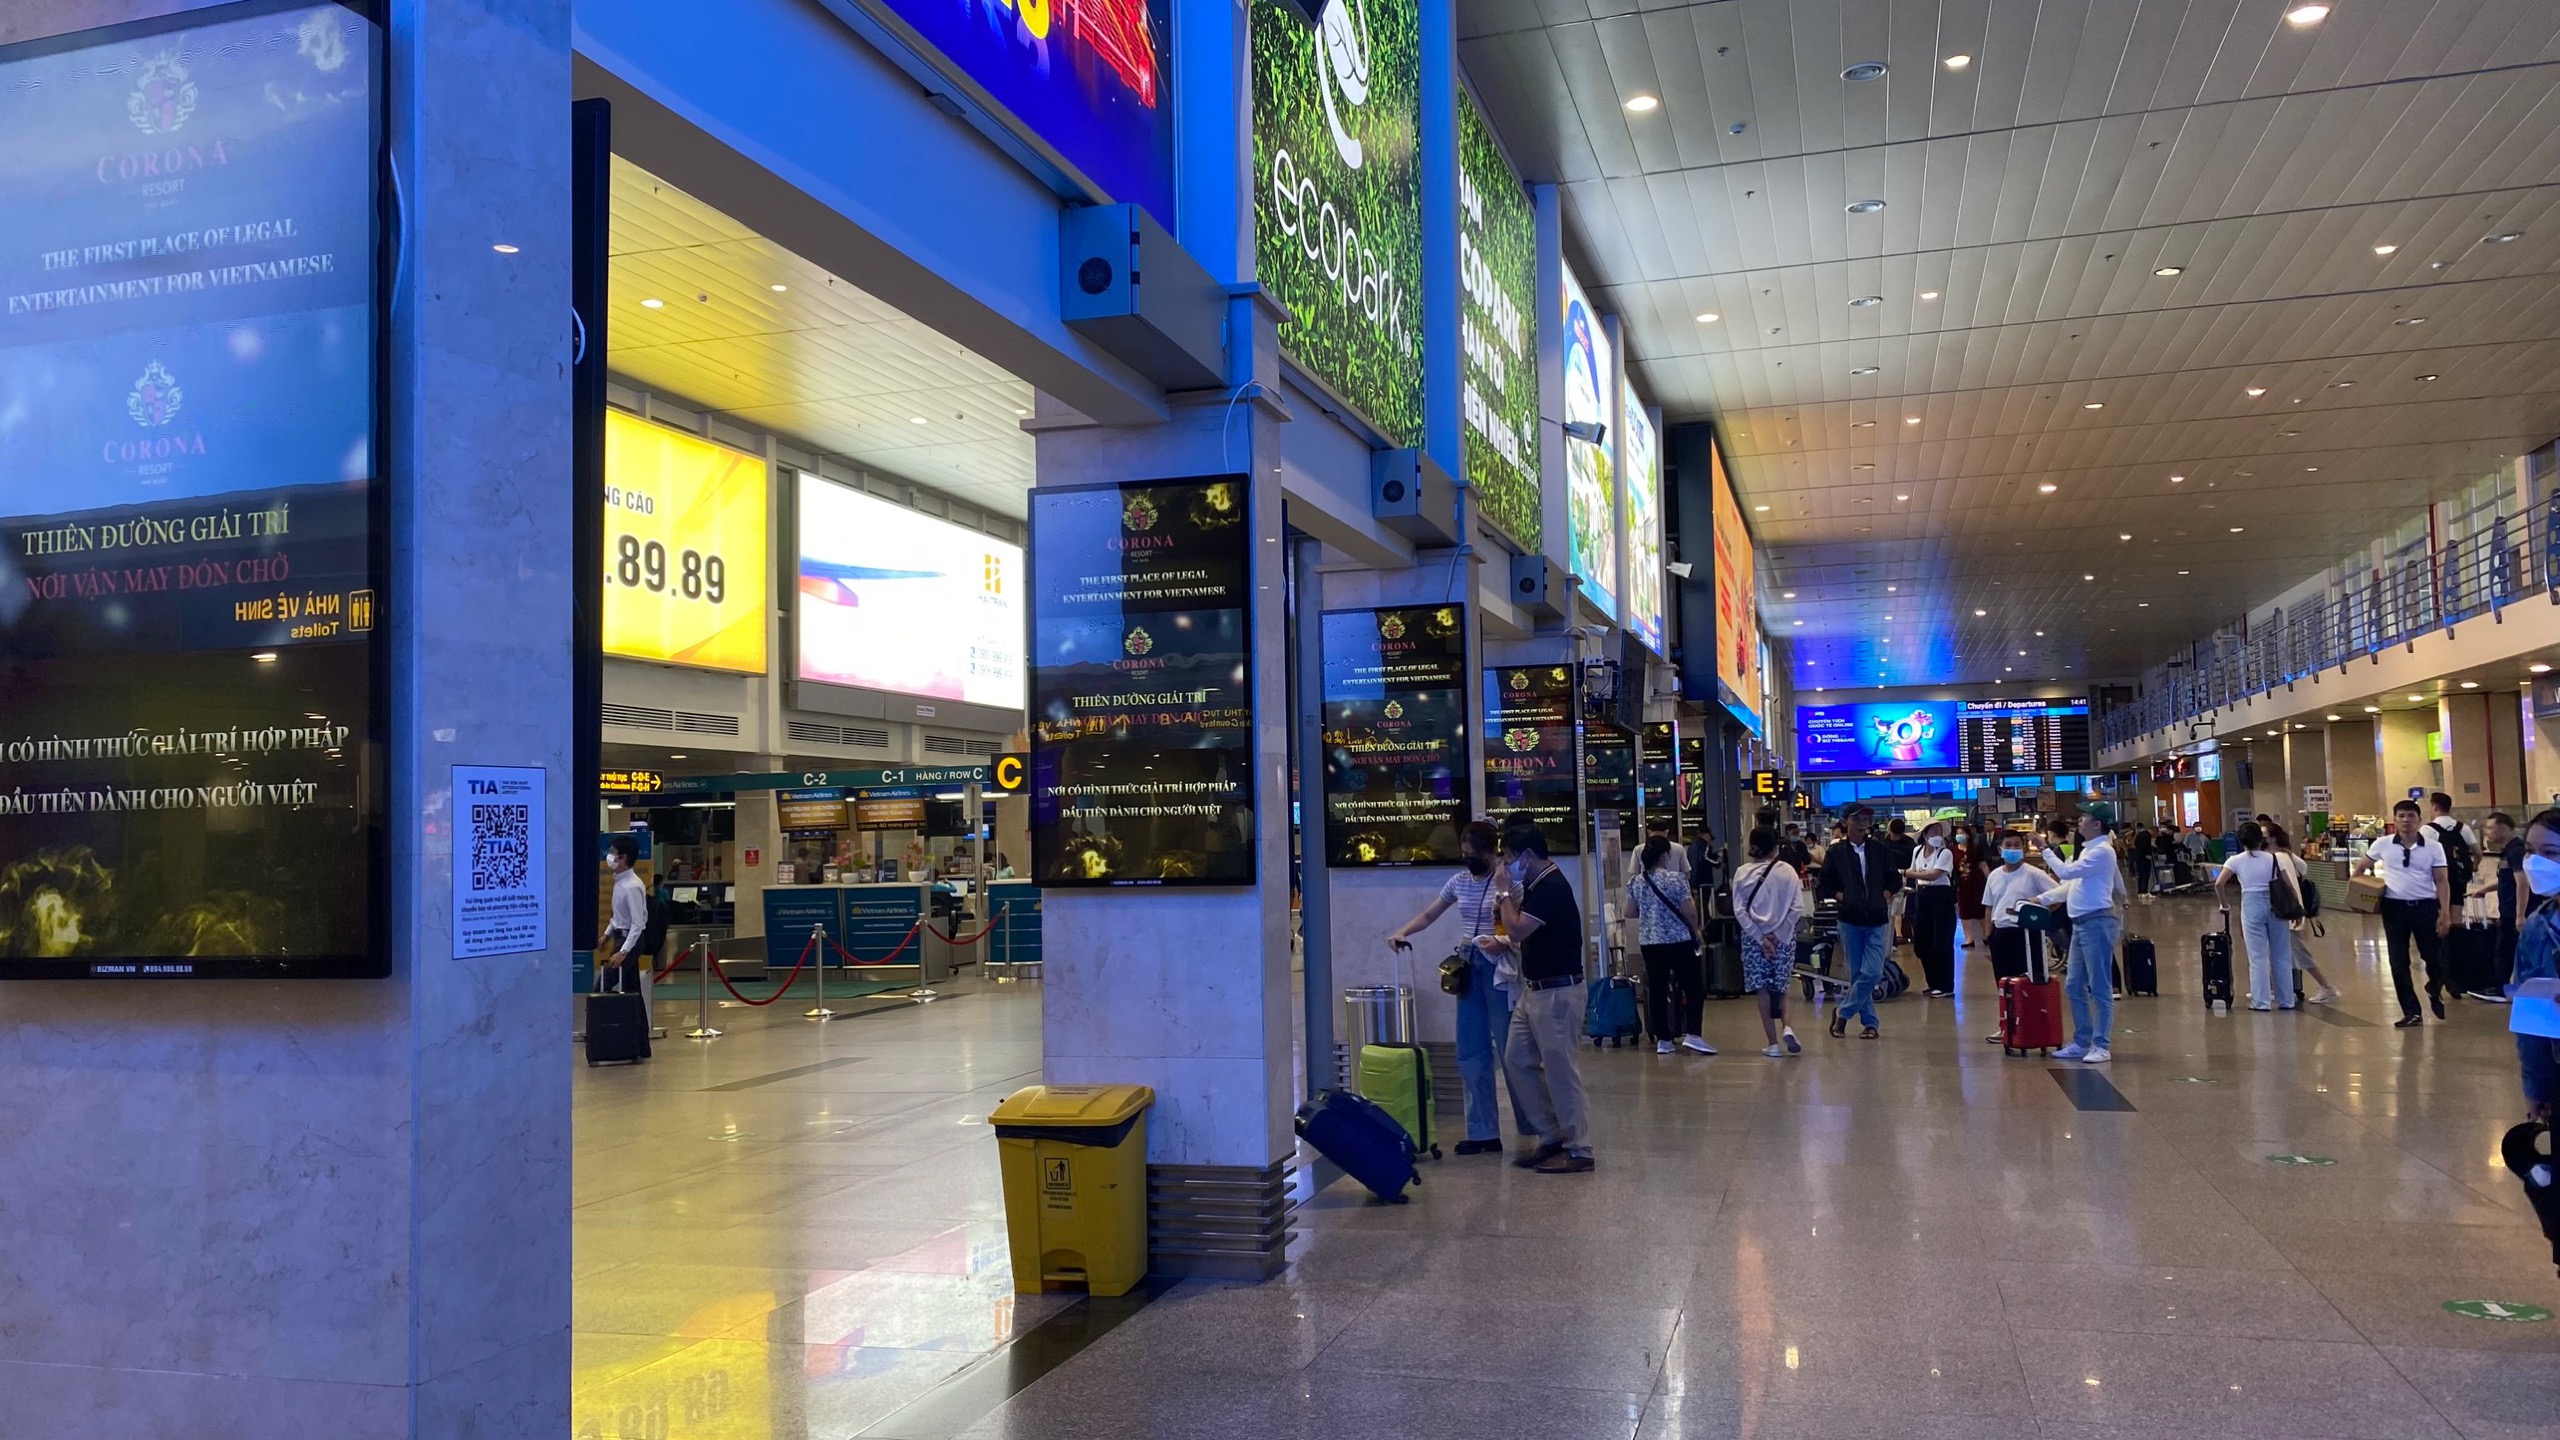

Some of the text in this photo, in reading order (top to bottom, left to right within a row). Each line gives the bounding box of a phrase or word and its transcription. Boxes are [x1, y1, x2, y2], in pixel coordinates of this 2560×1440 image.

[97, 140, 228, 185] CORONA
[142, 178, 185, 197] RESORT
[42, 218, 297, 271] THE FIRST PLACE OF LEGAL
[1274, 149, 1403, 353] ecopark
[9, 254, 334, 315] ENTERTAINMENT FOR VIETNAMESE
[104, 432, 206, 463] CORONA
[626, 491, 653, 515] CÁO
[22, 503, 290, 555] THIÊN ĐƯỜNG GIẢI TRÍ
[1107, 534, 1174, 550] CORONA
[27, 553, 289, 600] NƠI VẬN MAY ĐÓN CHỜ
[1080, 569, 1208, 585] THE FIRST PLACE OF LEGAL
[1063, 586, 1226, 603] ENTERTAINMENT FOR VIETNAMESE
[1372, 641, 1416, 651] CORONA
[1113, 659, 1165, 670] CORONA
[1073, 689, 1206, 708] THIÊN ĐƯỜNG GIẢI TRÍ
[1503, 691, 1537, 699] CORONA
[1967, 701, 1993, 710] Chuyến
[1994, 701, 2002, 709] đi
[2008, 701, 2046, 710] Departures
[1377, 721, 1412, 729] CORONA
[8, 735, 34, 762] CÓ
[38, 734, 91, 761] HÌNH
[93, 730, 149, 758] THỨC
[152, 727, 198, 755] GIẢI
[201, 725, 238, 752] TRÍ
[242, 726, 286, 756] HỢP
[290, 721, 349, 748] PHÁP
[1492, 756, 1556, 768] CORONA
[631, 771, 650, 781] C-D-E
[803, 770, 904, 785] C-2 C-1
[916, 767, 983, 780] HÀNG / ROW C
[997, 757, 1022, 789] C
[468, 780, 498, 794] TIA
[632, 782, 650, 791] F-G-H
[1048, 780, 1237, 796] NƠI CÓ HÌNH THỨC GIẢI TRÍ HỢP PHÁP
[1757, 773, 1773, 792] E
[0, 778, 317, 815] ĐẦU TIÊN DÀNH CHO NGƯỜI VIỆT
[1062, 803, 1222, 818] ĐẦU TIÊN DÀNH CHO NGƯỜI VIỆT
[486, 841, 513, 853] TIA
